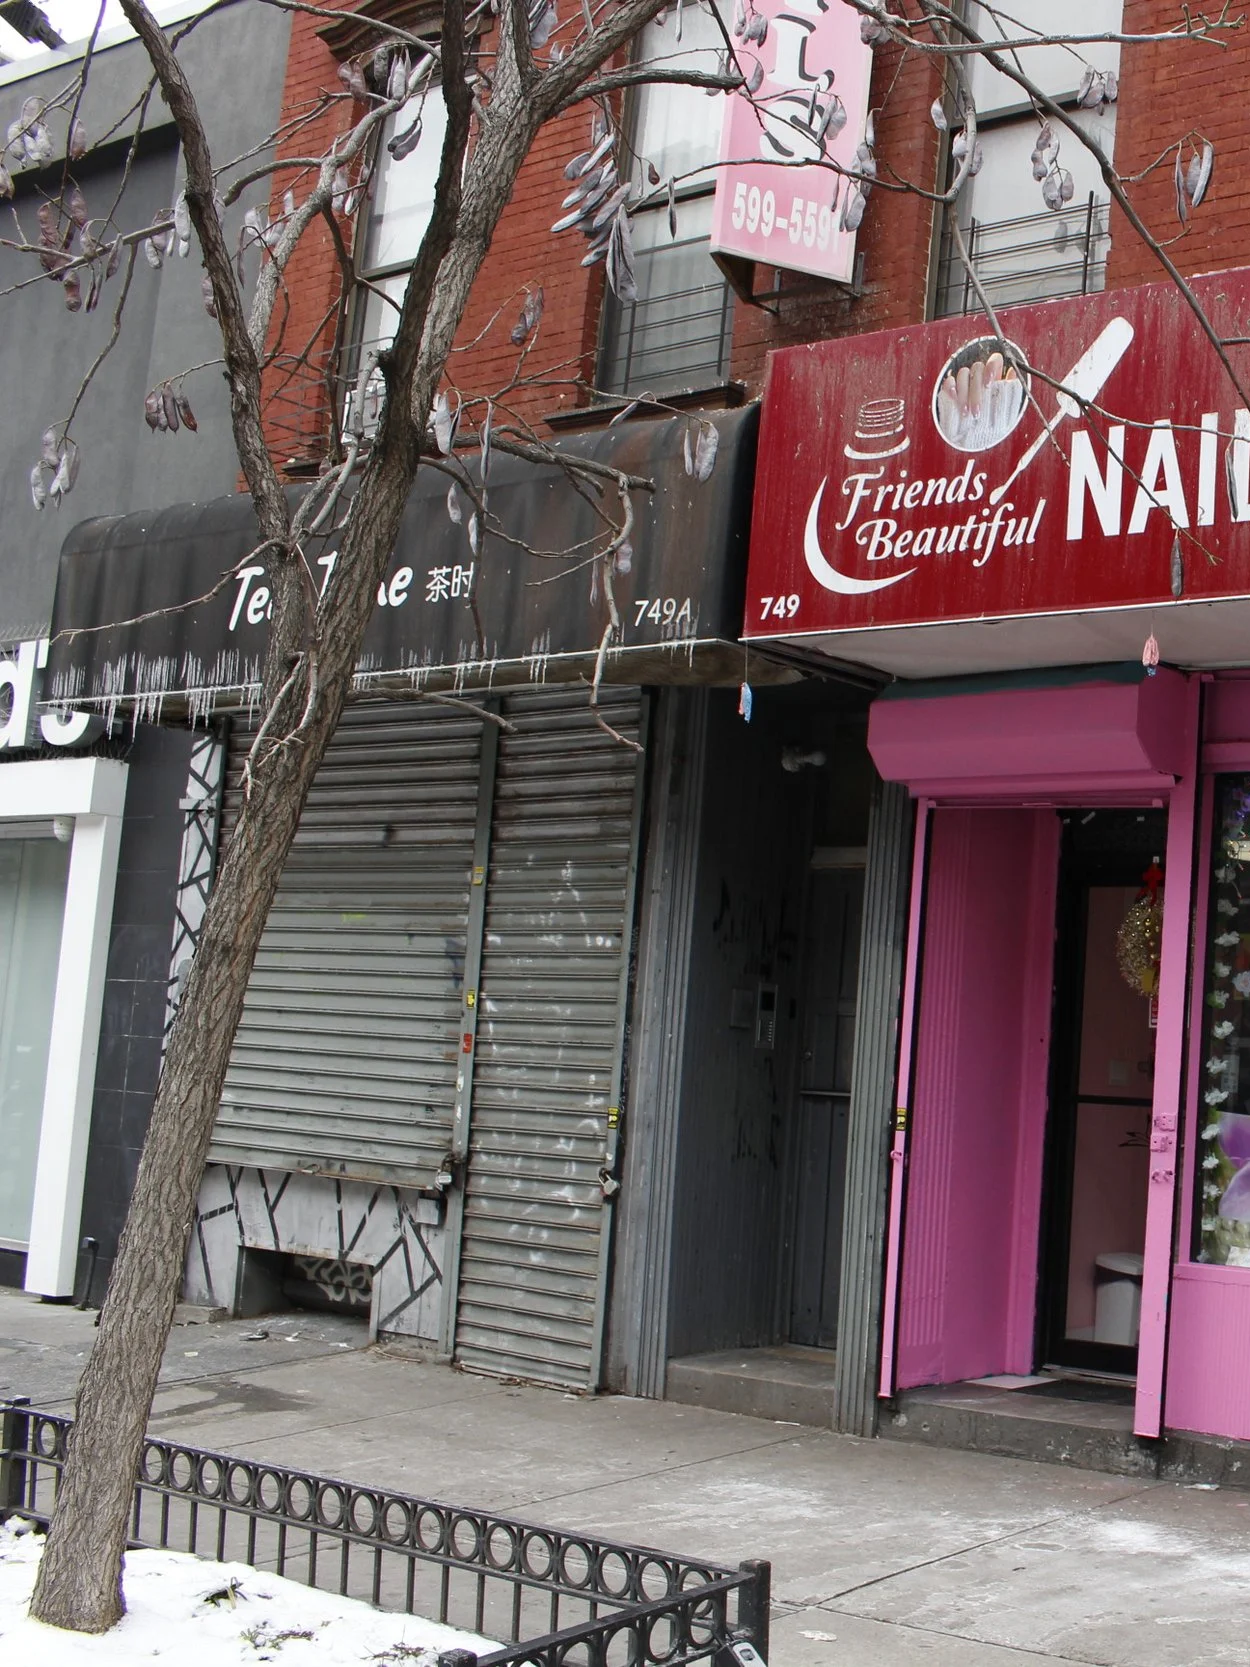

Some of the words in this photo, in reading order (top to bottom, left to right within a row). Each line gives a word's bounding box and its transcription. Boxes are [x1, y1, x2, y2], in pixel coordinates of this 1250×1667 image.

[731, 182, 841, 254] 599-5591
[835, 459, 987, 530] Friends
[855, 498, 1046, 567] Beautiful
[228, 565, 273, 632] Te
[634, 597, 692, 627] 749A
[760, 594, 800, 620] 749
